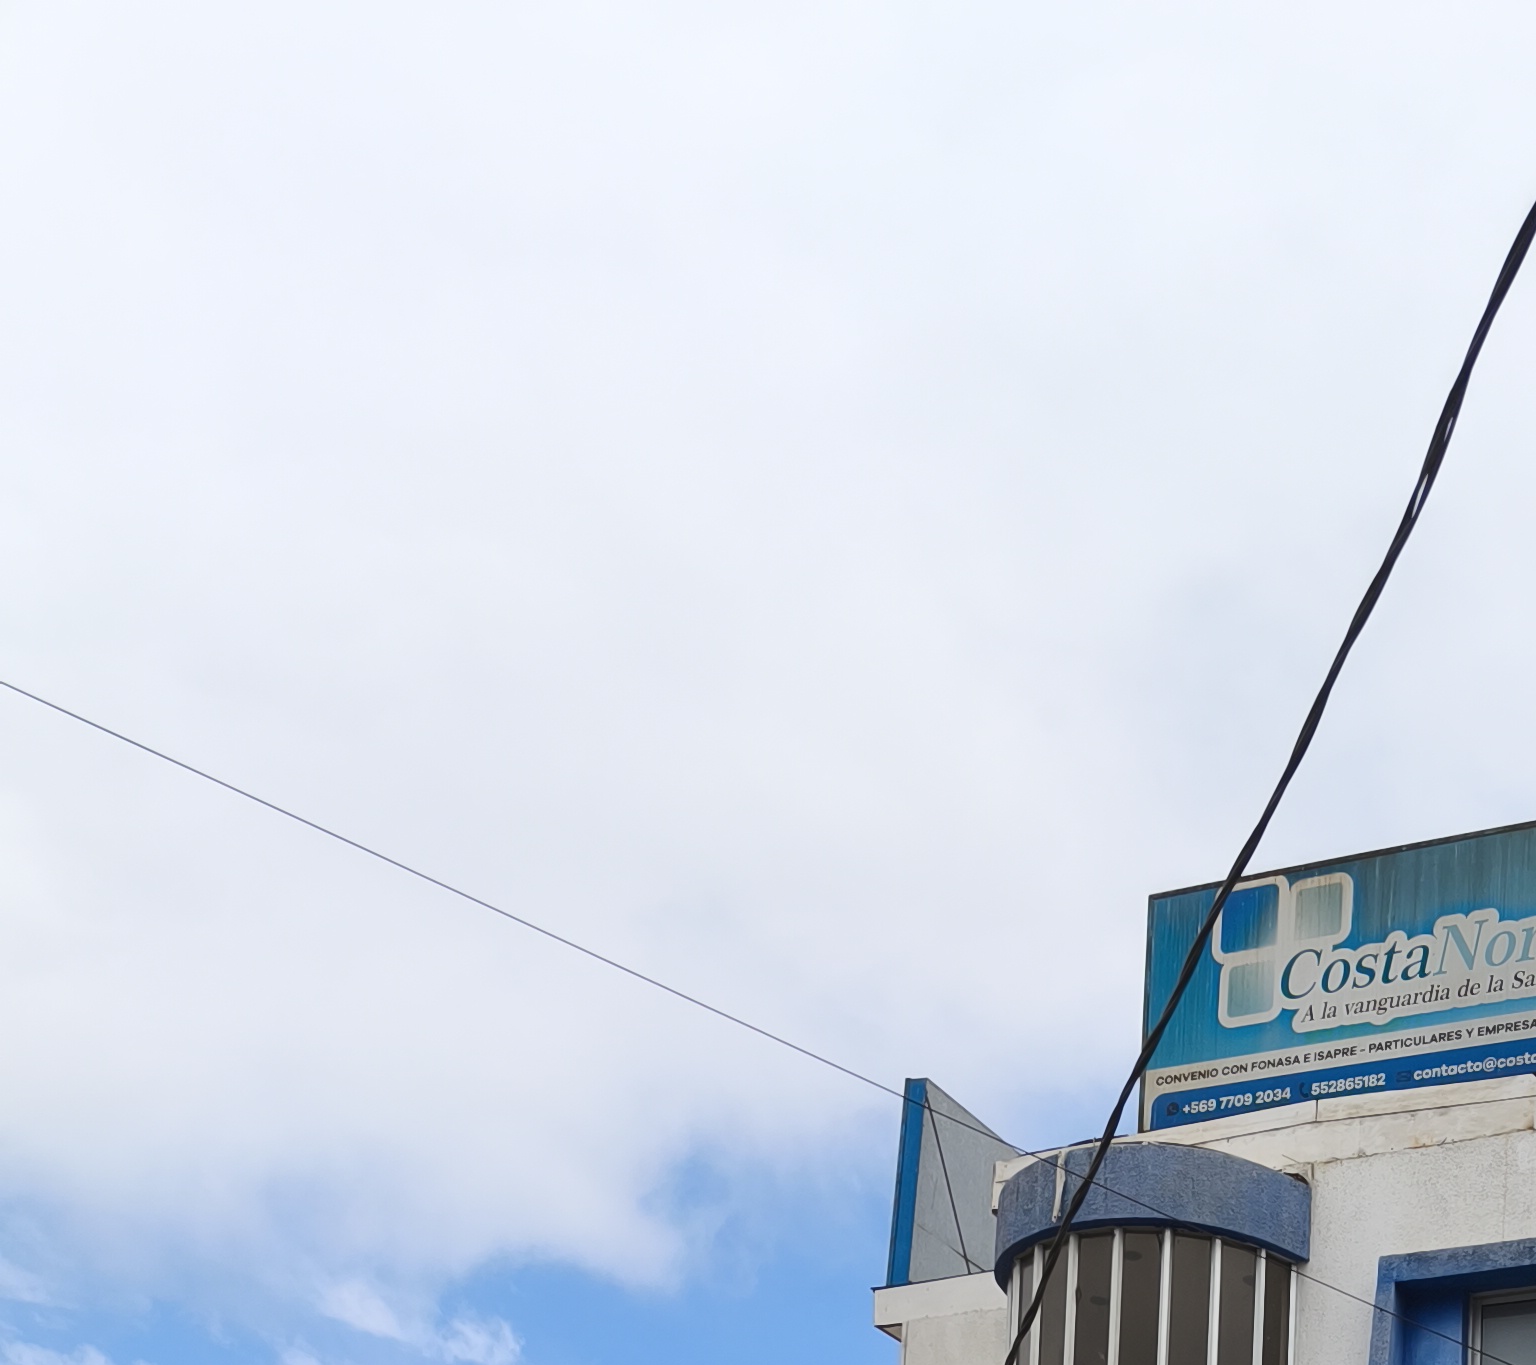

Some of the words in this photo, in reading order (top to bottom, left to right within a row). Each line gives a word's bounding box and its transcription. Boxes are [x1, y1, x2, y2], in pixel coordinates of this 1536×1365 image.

[1301, 1004, 1315, 1022] A
[1321, 1001, 1337, 1019] la
[1345, 983, 1451, 1015] vanguardia
[1457, 978, 1481, 998] de
[1485, 974, 1504, 993] la
[1156, 1068, 1219, 1086] CONVENIO
[1221, 1063, 1248, 1076] CON
[1251, 1055, 1301, 1072] FONASA
[1303, 1053, 1311, 1063] E
[1314, 1045, 1357, 1062] ISAPRE
[1368, 1029, 1463, 1053] PARTICULARES
[1465, 1028, 1474, 1038] Y
[1182, 1098, 1216, 1114] +569
[1219, 1093, 1253, 1110] 7709
[1255, 1087, 1291, 1104] 2034
[1311, 1072, 1386, 1096] 552865182
